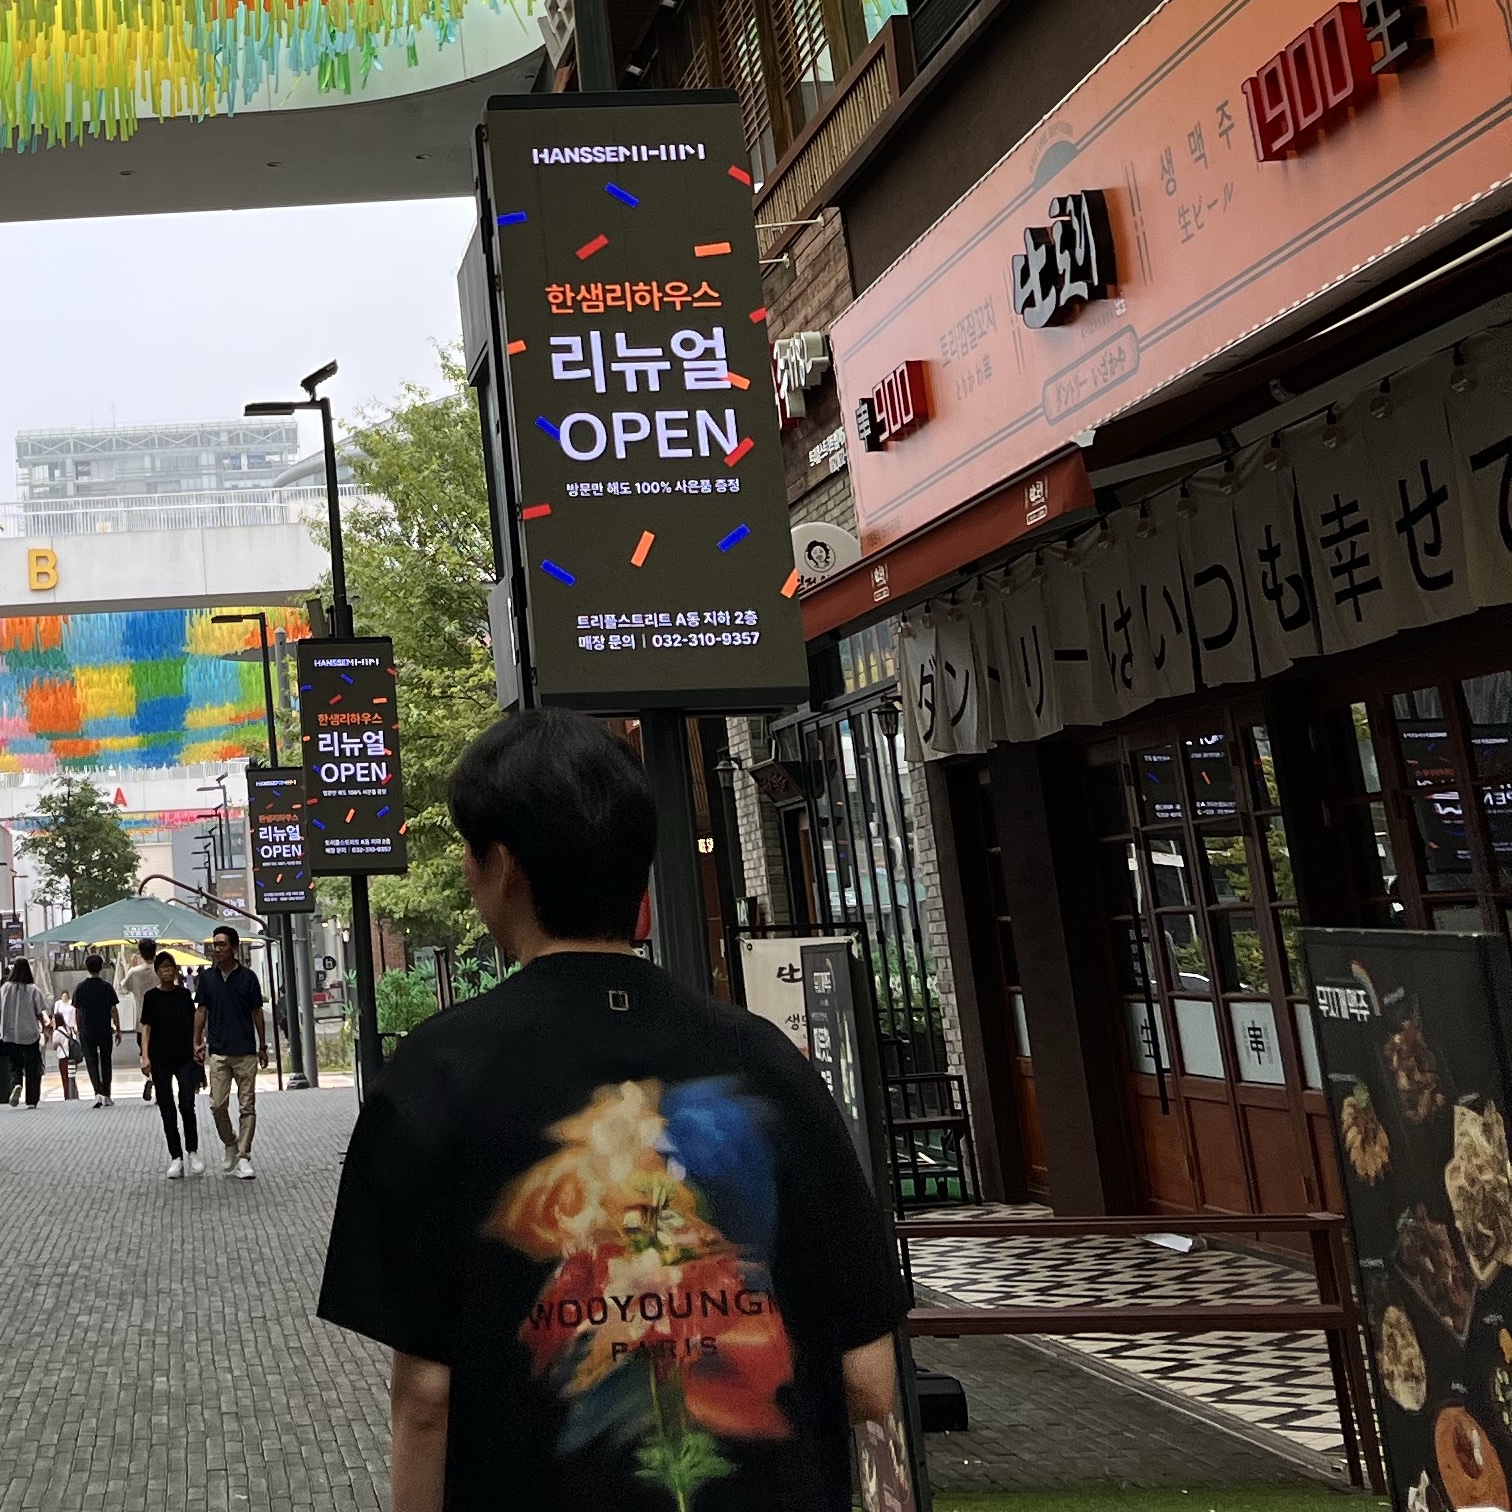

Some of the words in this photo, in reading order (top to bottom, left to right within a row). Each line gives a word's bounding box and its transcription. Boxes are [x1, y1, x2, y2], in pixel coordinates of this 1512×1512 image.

[545, 281, 722, 314] 한샘리하우스
[549, 327, 732, 394] 리뉴얼
[559, 408, 739, 461] OPEN
[566, 482, 603, 497] 방문만
[606, 481, 632, 496] 해도
[634, 480, 672, 494] 100%
[674, 479, 712, 494] 사은품
[714, 478, 740, 493] 증정
[28, 548, 59, 590] B
[576, 612, 672, 630] 트리플스트리트
[675, 611, 701, 627] A동
[703, 610, 731, 627] 지하
[734, 610, 758, 626] 2층
[578, 634, 605, 651] 매장
[607, 633, 636, 650] 문의
[651, 632, 760, 648] 032-310-9357
[317, 713, 383, 726] 한샘리하우스
[318, 730, 386, 757] 리뉴얼
[320, 762, 387, 783] OPEN
[112, 787, 128, 807] A
[259, 824, 301, 842] 리뉴얼
[260, 844, 302, 859] OPEN
